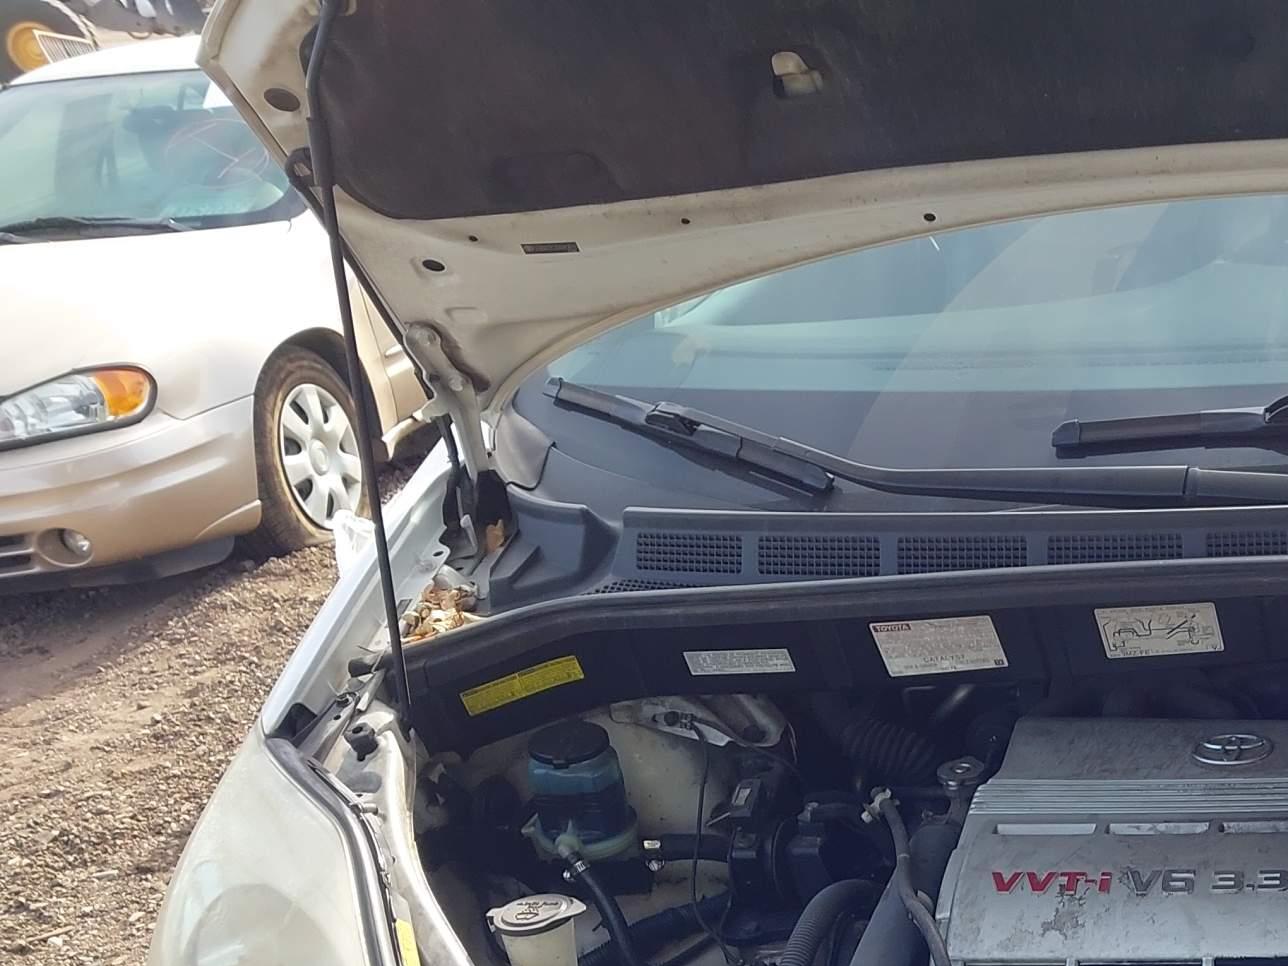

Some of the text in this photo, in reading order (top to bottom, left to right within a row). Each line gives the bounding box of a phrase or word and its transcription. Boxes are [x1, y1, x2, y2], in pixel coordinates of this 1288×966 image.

[875, 624, 911, 633] TOYOTA
[922, 654, 966, 664] CATALYST
[991, 871, 1112, 895] VVT-i
[1128, 869, 1197, 895] V6
